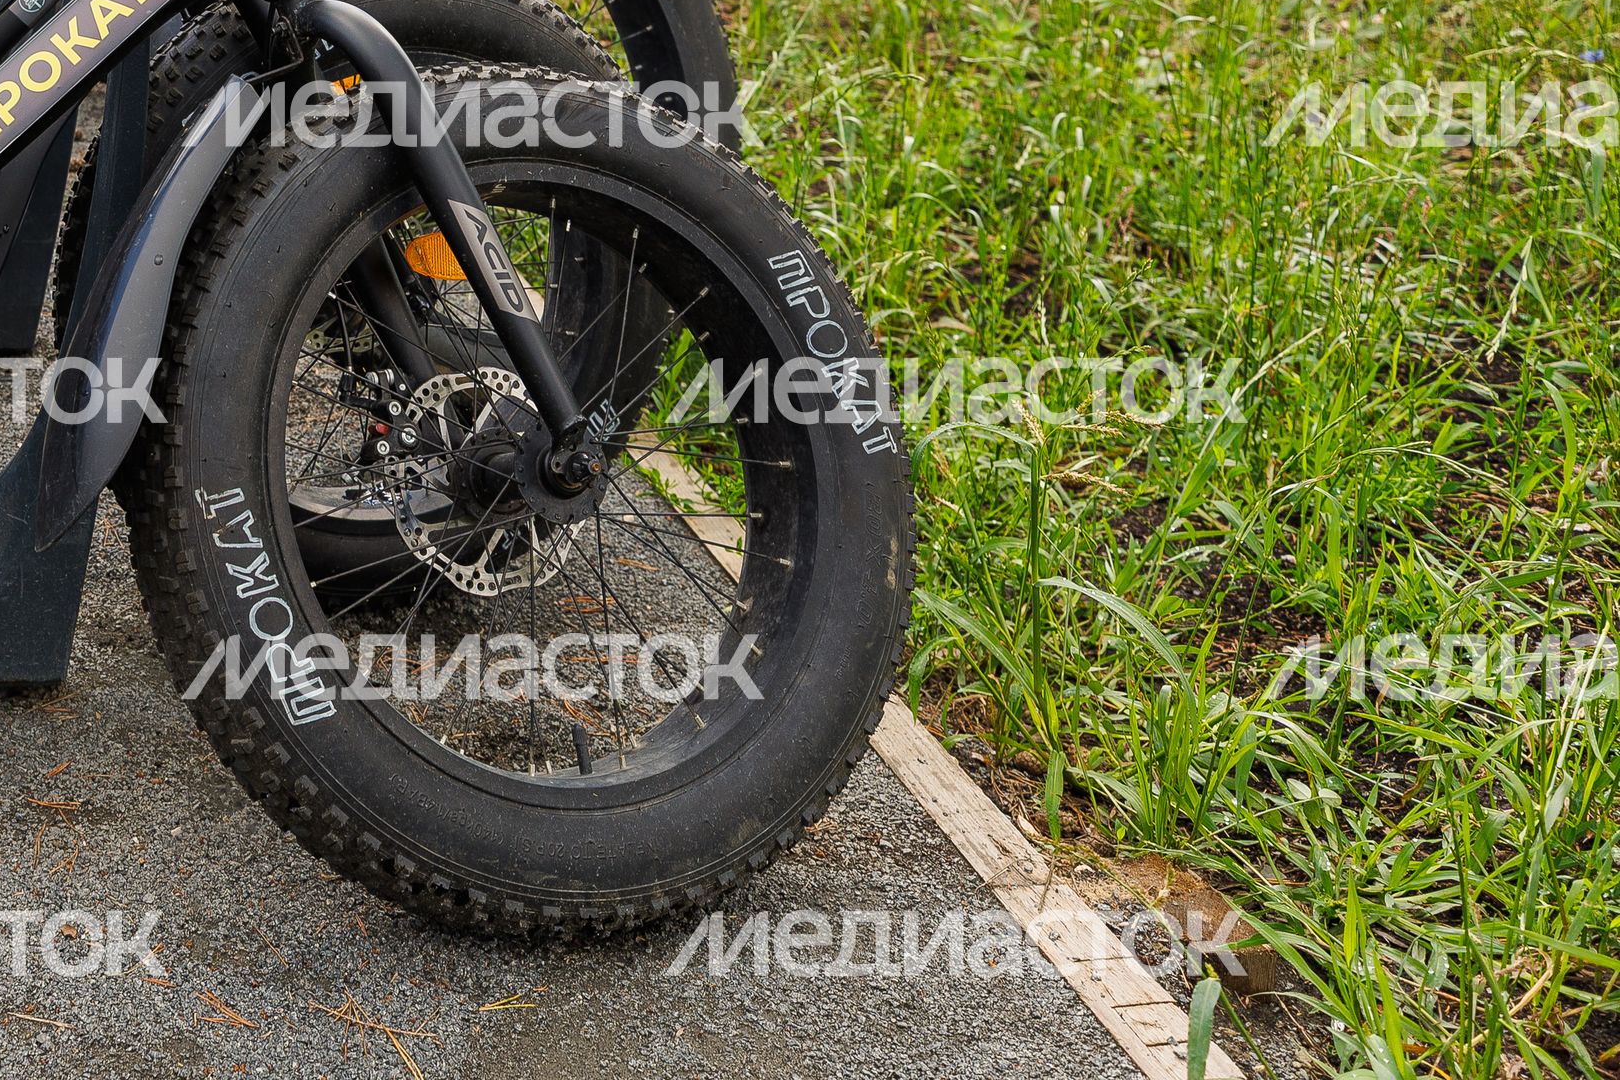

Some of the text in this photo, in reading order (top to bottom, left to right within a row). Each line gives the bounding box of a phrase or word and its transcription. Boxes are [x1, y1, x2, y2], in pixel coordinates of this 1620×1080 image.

[464, 208, 524, 313] ACID
[767, 249, 898, 455] ПРОКАТ
[195, 486, 337, 726] ПРОКАТ
